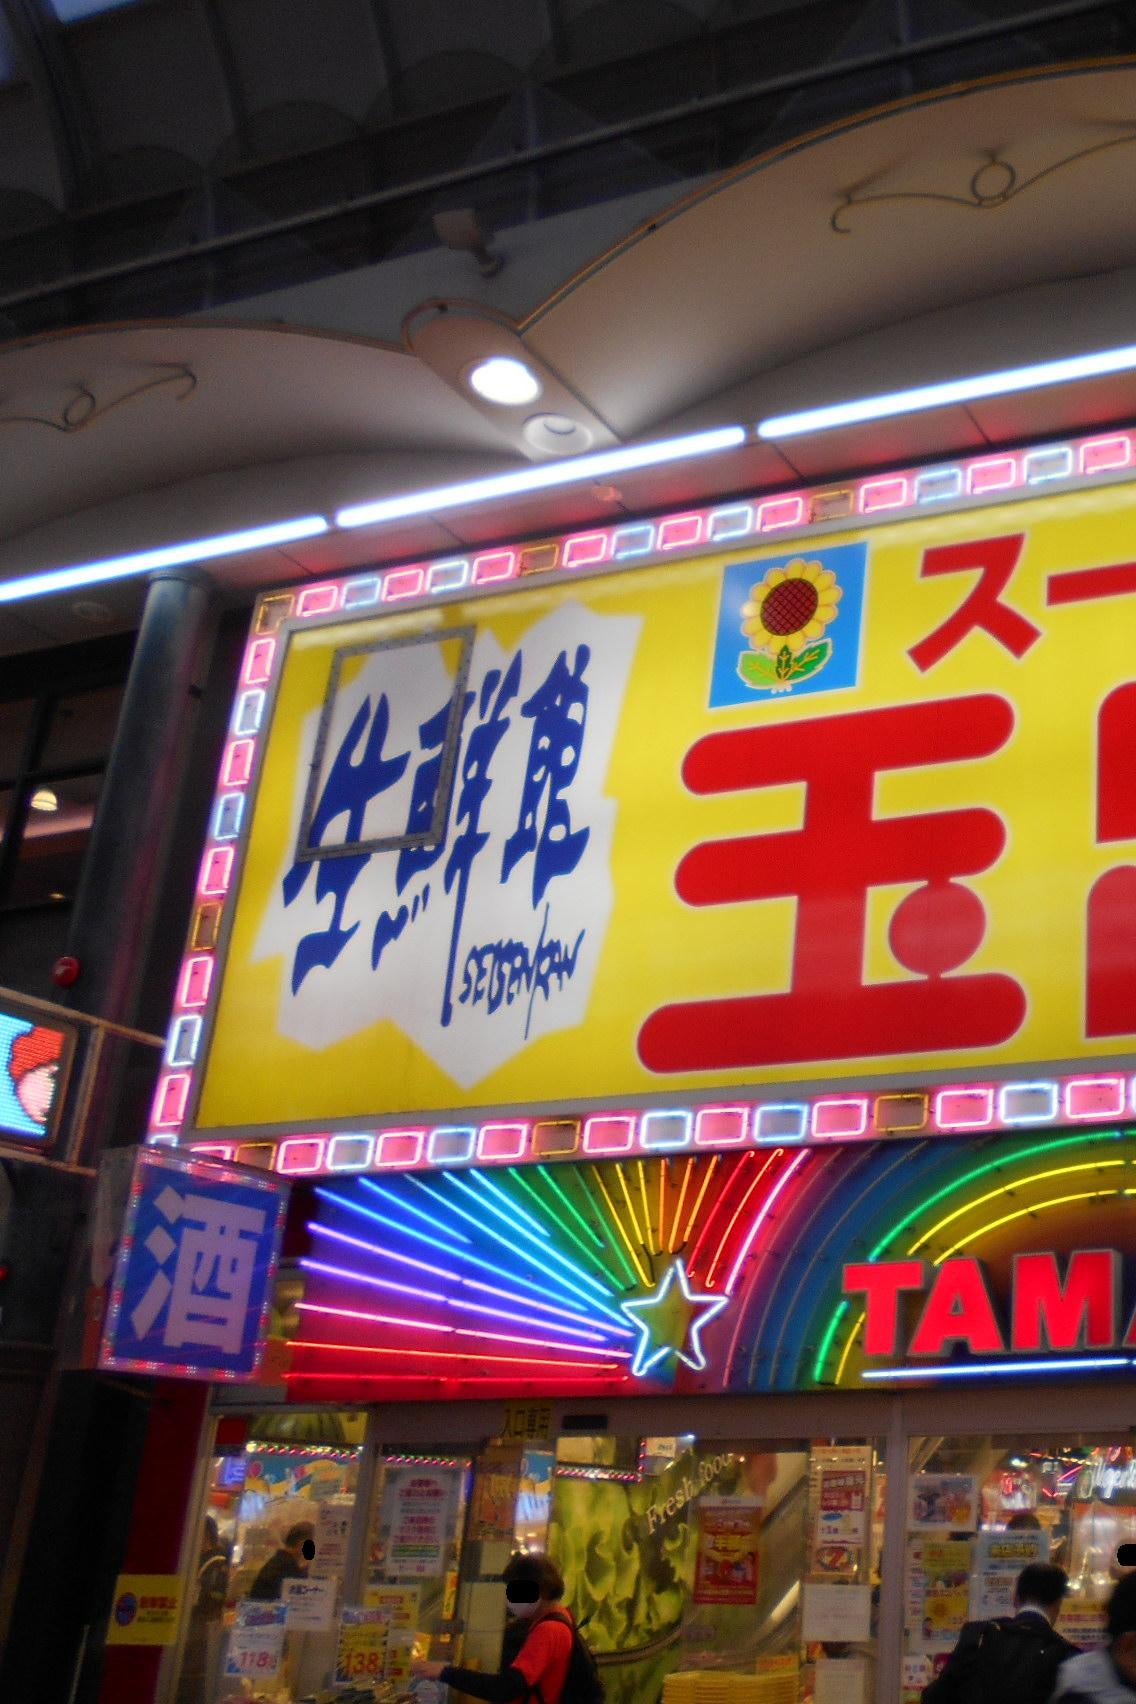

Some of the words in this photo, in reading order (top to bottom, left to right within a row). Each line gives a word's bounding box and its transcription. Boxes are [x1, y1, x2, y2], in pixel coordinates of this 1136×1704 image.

[283, 643, 591, 1028] 生鮮館
[131, 1185, 267, 1355] 酒
